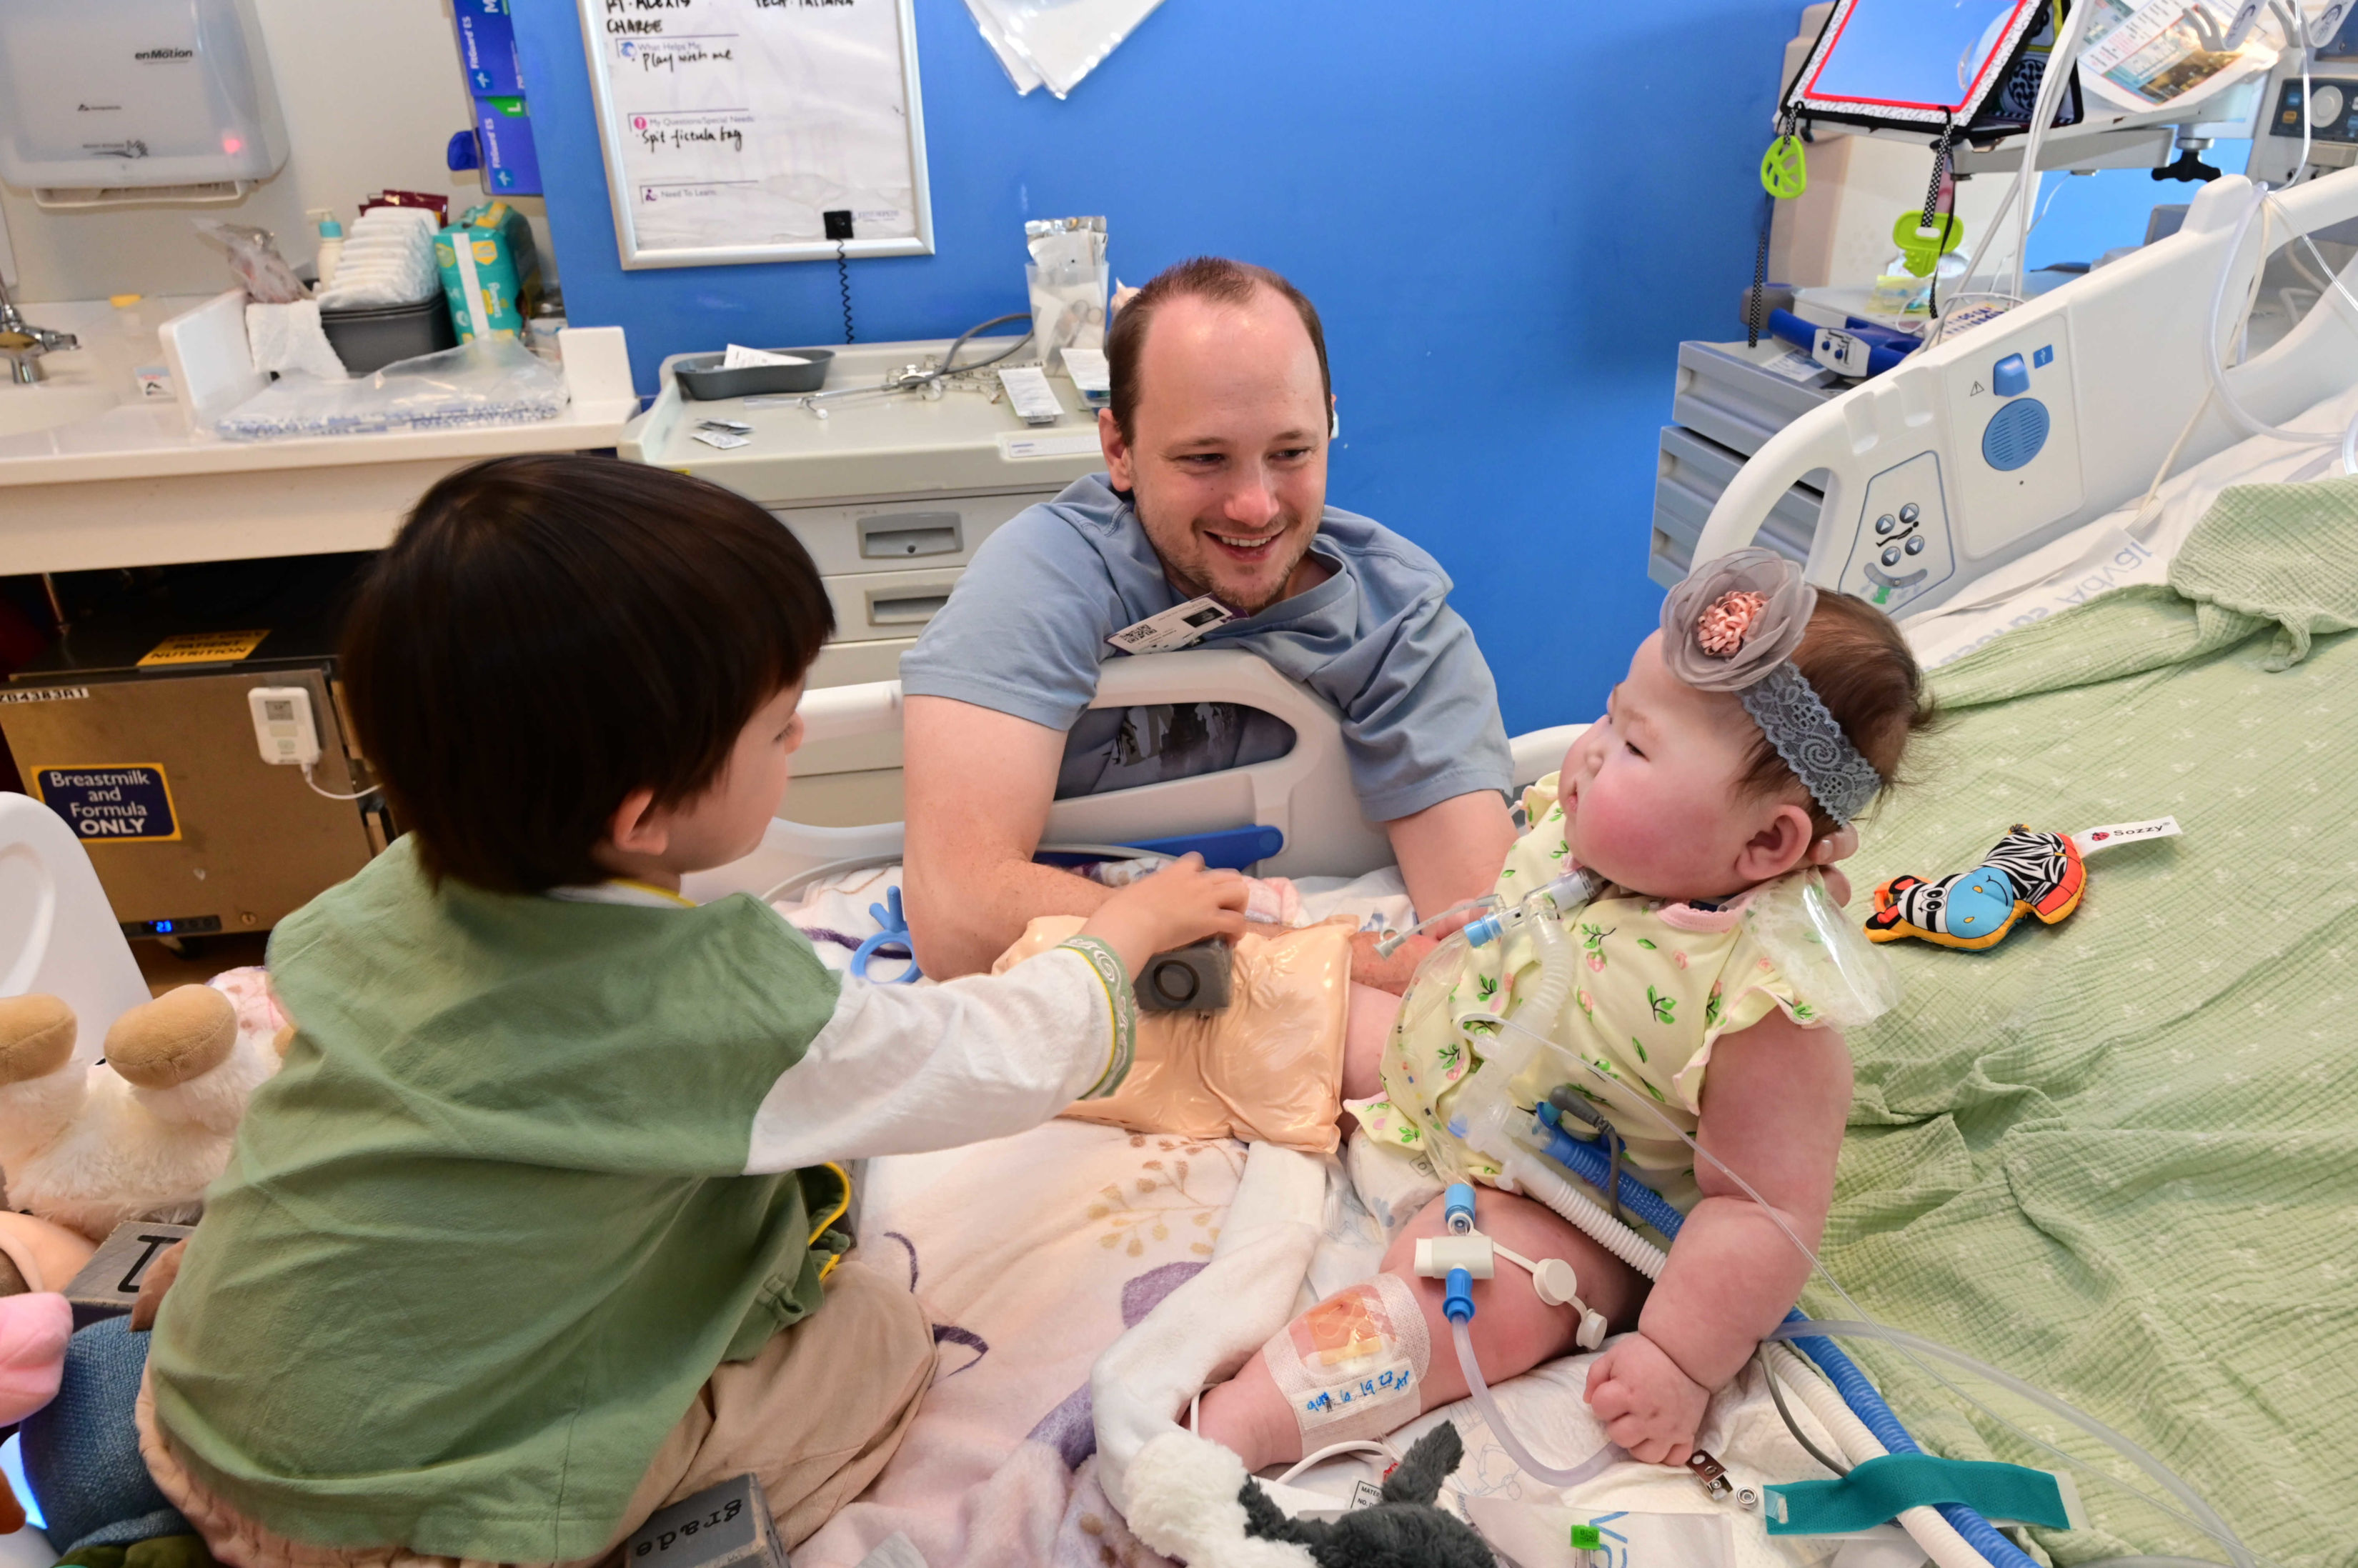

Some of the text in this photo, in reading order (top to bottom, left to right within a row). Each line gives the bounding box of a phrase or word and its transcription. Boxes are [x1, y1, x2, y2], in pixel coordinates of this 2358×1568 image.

[607, 19, 662, 34] CHARGE
[135, 48, 193, 60] enMotion
[507, 102, 522, 112] L
[49, 769, 151, 787] Breastmilk
[87, 787, 121, 802] and
[70, 802, 148, 818] Formula
[79, 818, 145, 835] ONLY
[636, 1499, 743, 1557] grade
